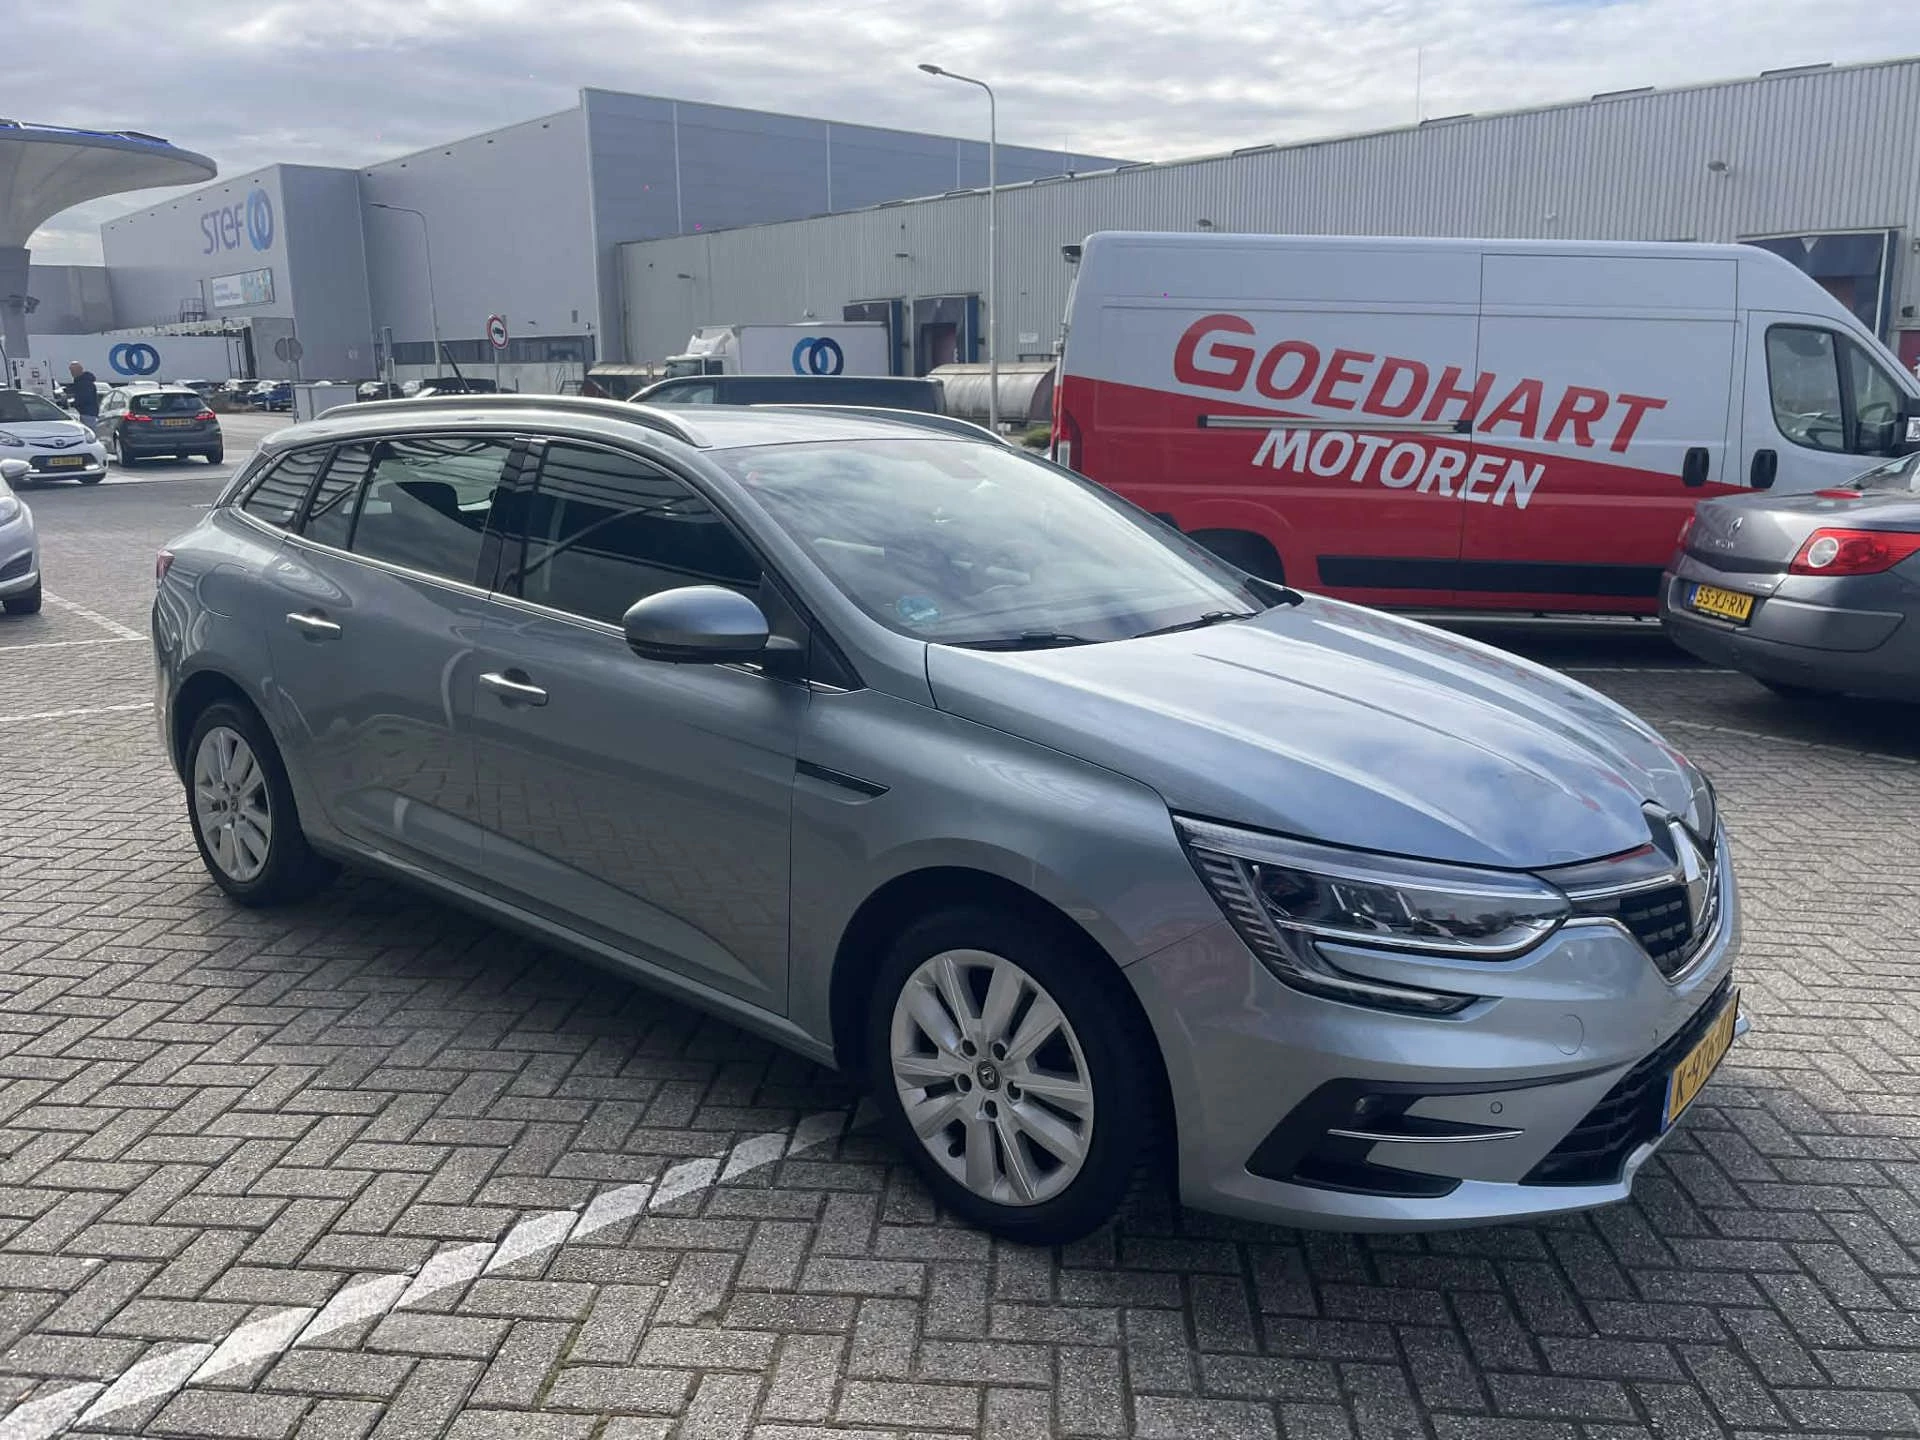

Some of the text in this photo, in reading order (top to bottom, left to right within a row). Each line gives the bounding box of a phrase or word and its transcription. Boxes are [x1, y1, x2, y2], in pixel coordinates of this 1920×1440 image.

[1173, 313, 1668, 454] GOEDHART
[1252, 428, 1546, 510] MOTOREN
[1696, 586, 1747, 614] 55-XJ-RN
